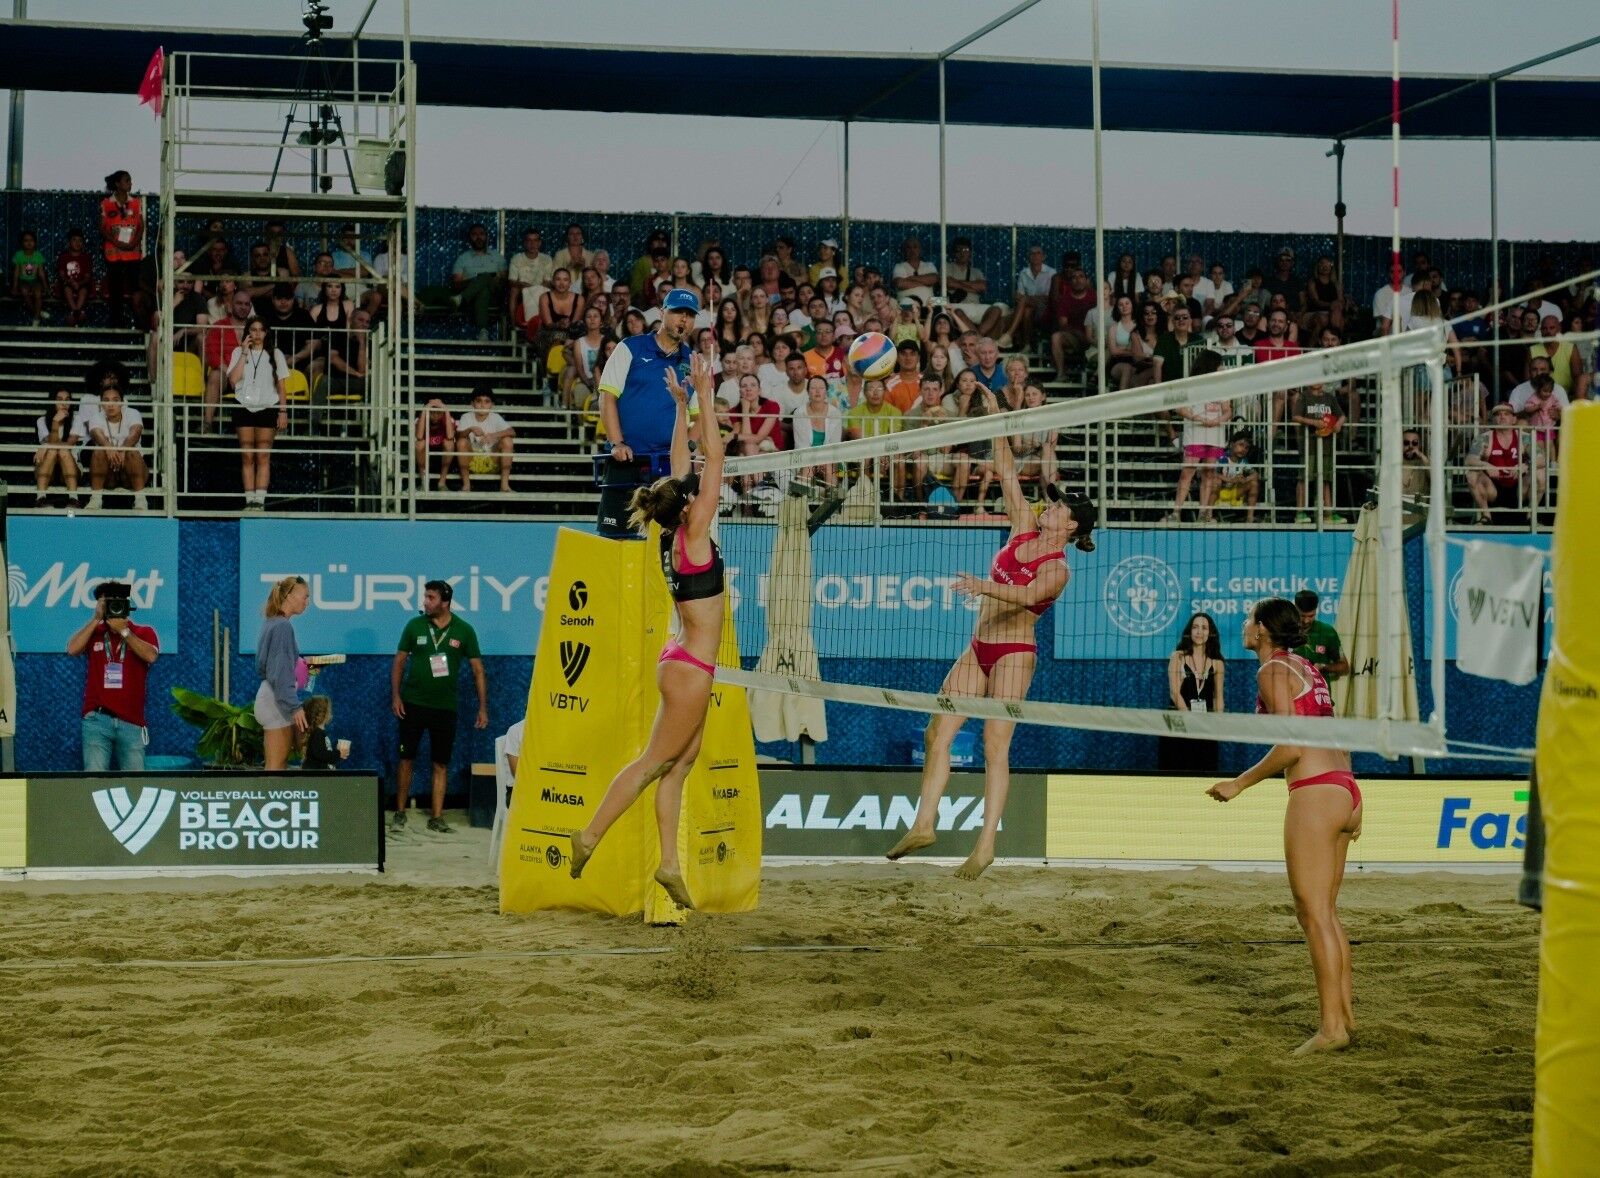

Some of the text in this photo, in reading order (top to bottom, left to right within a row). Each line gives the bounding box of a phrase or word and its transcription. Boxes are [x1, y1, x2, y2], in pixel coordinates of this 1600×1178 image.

[1510, 448, 1518, 459] 2
[757, 573, 982, 611] OJECT
[1190, 574, 1338, 596] T.C. GENÇLİK VE
[1191, 598, 1239, 615] SPOR
[560, 614, 594, 626] Senoh
[549, 692, 589, 713] VBTV
[180, 790, 319, 800] VOLLEYBALL WORLD
[180, 801, 319, 829] BEACH
[180, 830, 319, 850] PRO TOUR
[520, 843, 541, 854] ALANYA
